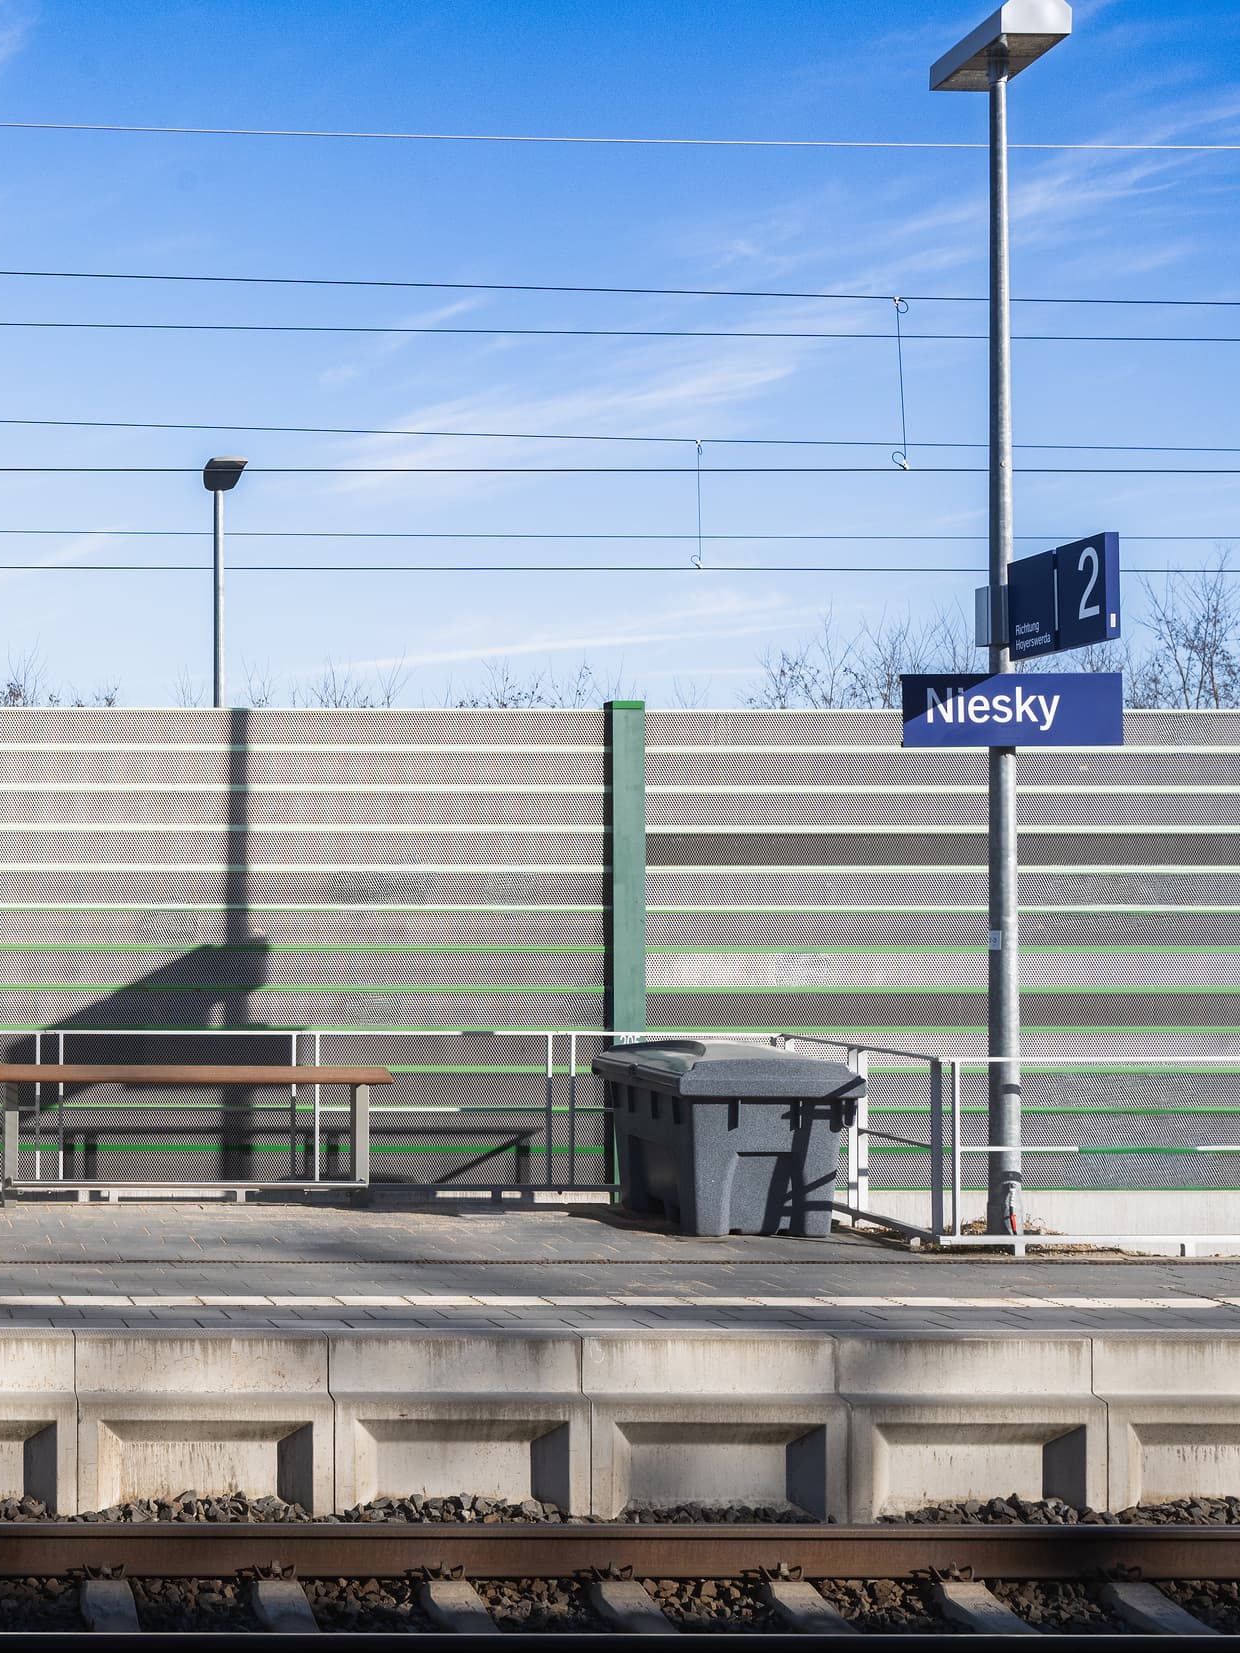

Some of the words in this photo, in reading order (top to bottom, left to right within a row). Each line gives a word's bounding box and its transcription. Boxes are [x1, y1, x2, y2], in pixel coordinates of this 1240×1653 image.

[1077, 546, 1100, 620] 2
[1015, 622, 1040, 636] Richtung
[1015, 633, 1051, 651] Hoyerswerda
[927, 686, 1061, 731] Niesky
